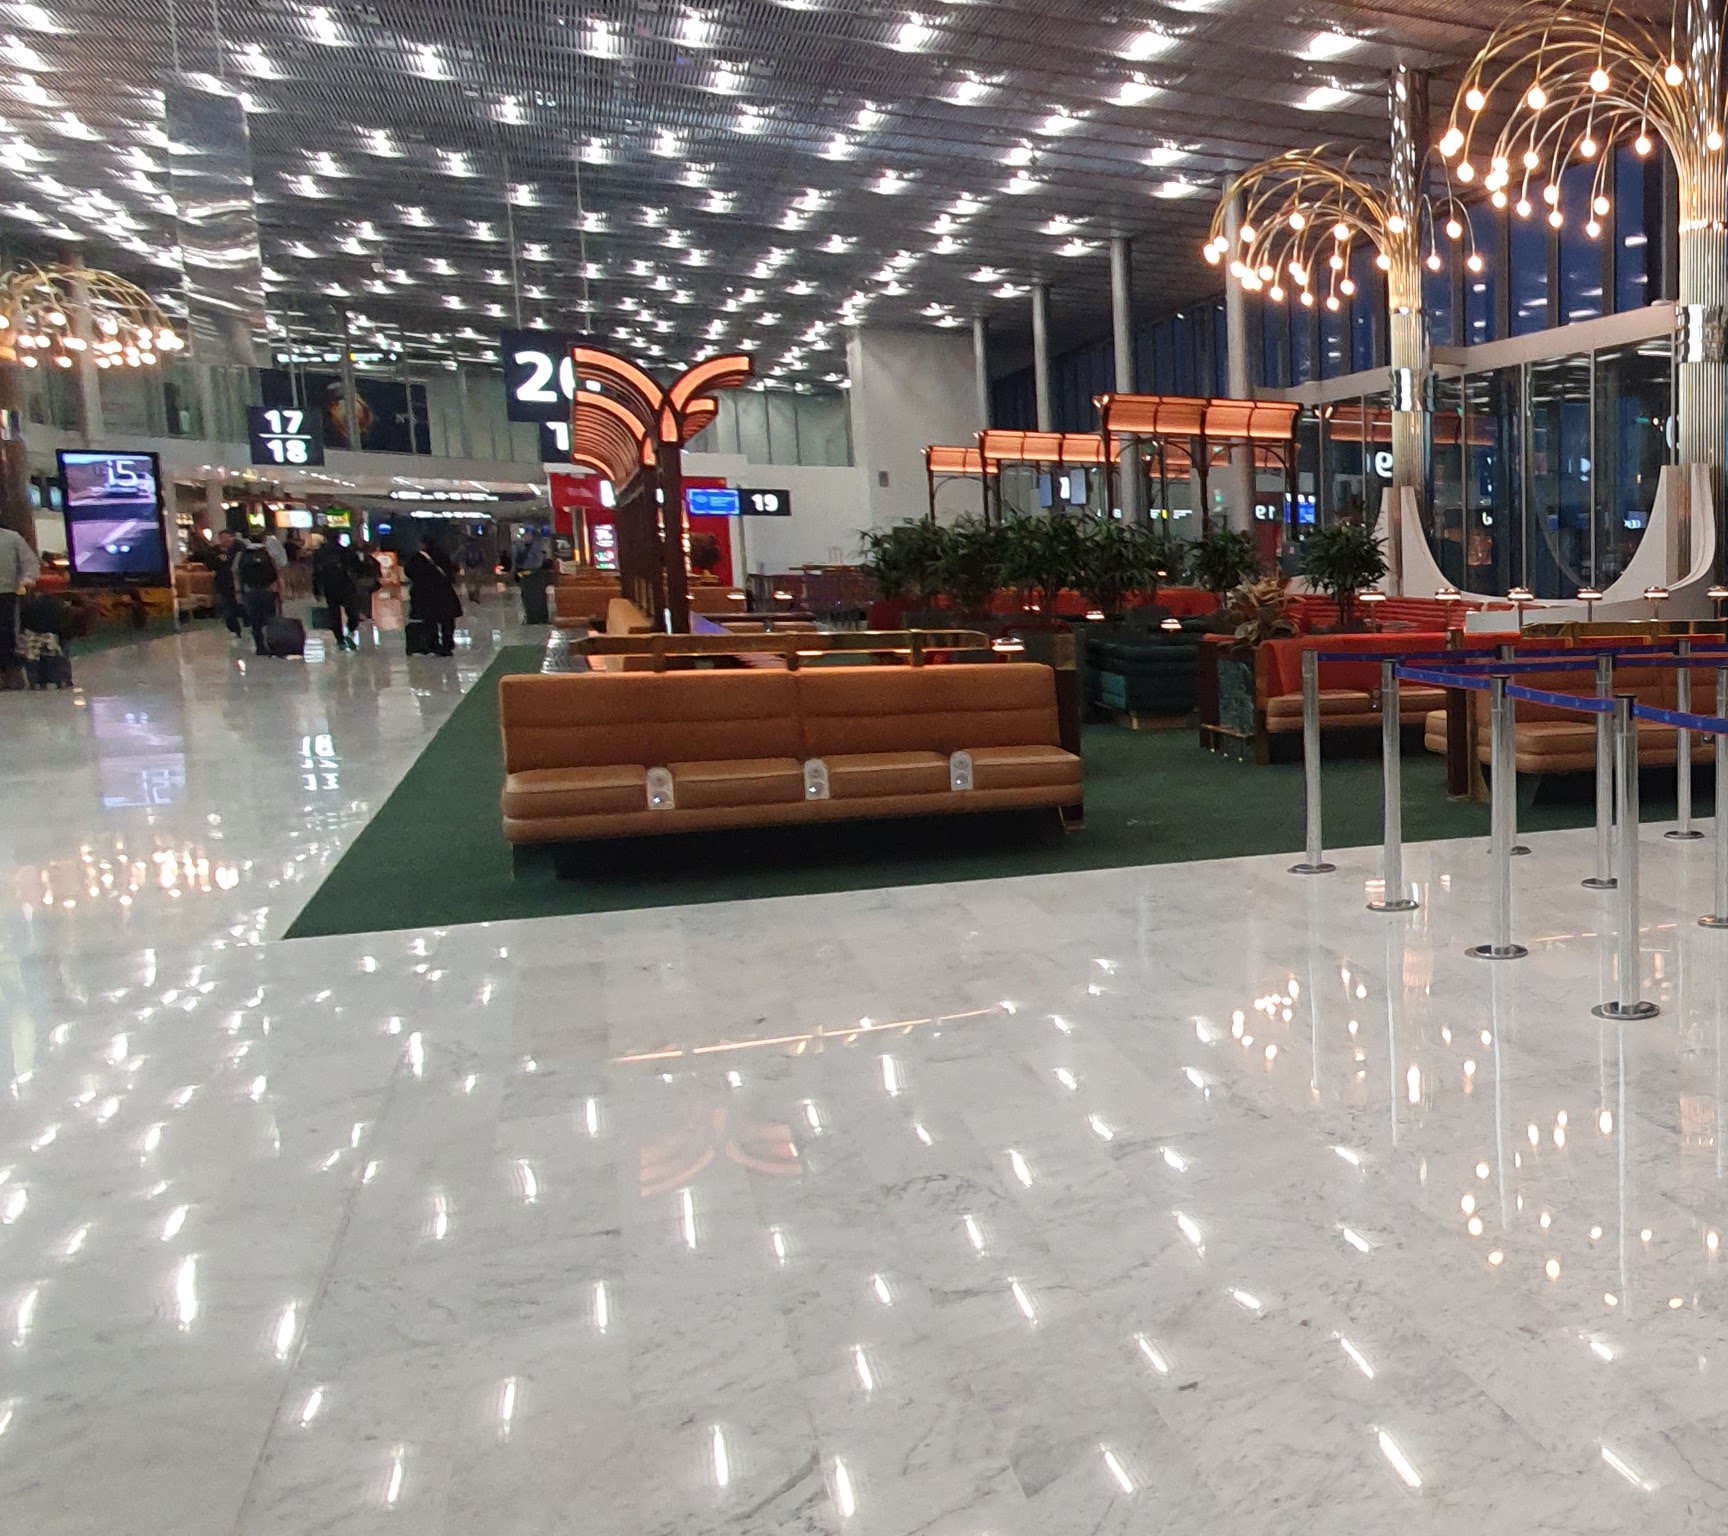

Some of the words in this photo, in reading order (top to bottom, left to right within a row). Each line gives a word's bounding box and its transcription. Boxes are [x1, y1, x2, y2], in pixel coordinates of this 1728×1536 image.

[264, 410, 304, 433] 17
[266, 439, 308, 463] 18
[751, 494, 779, 511] 19
